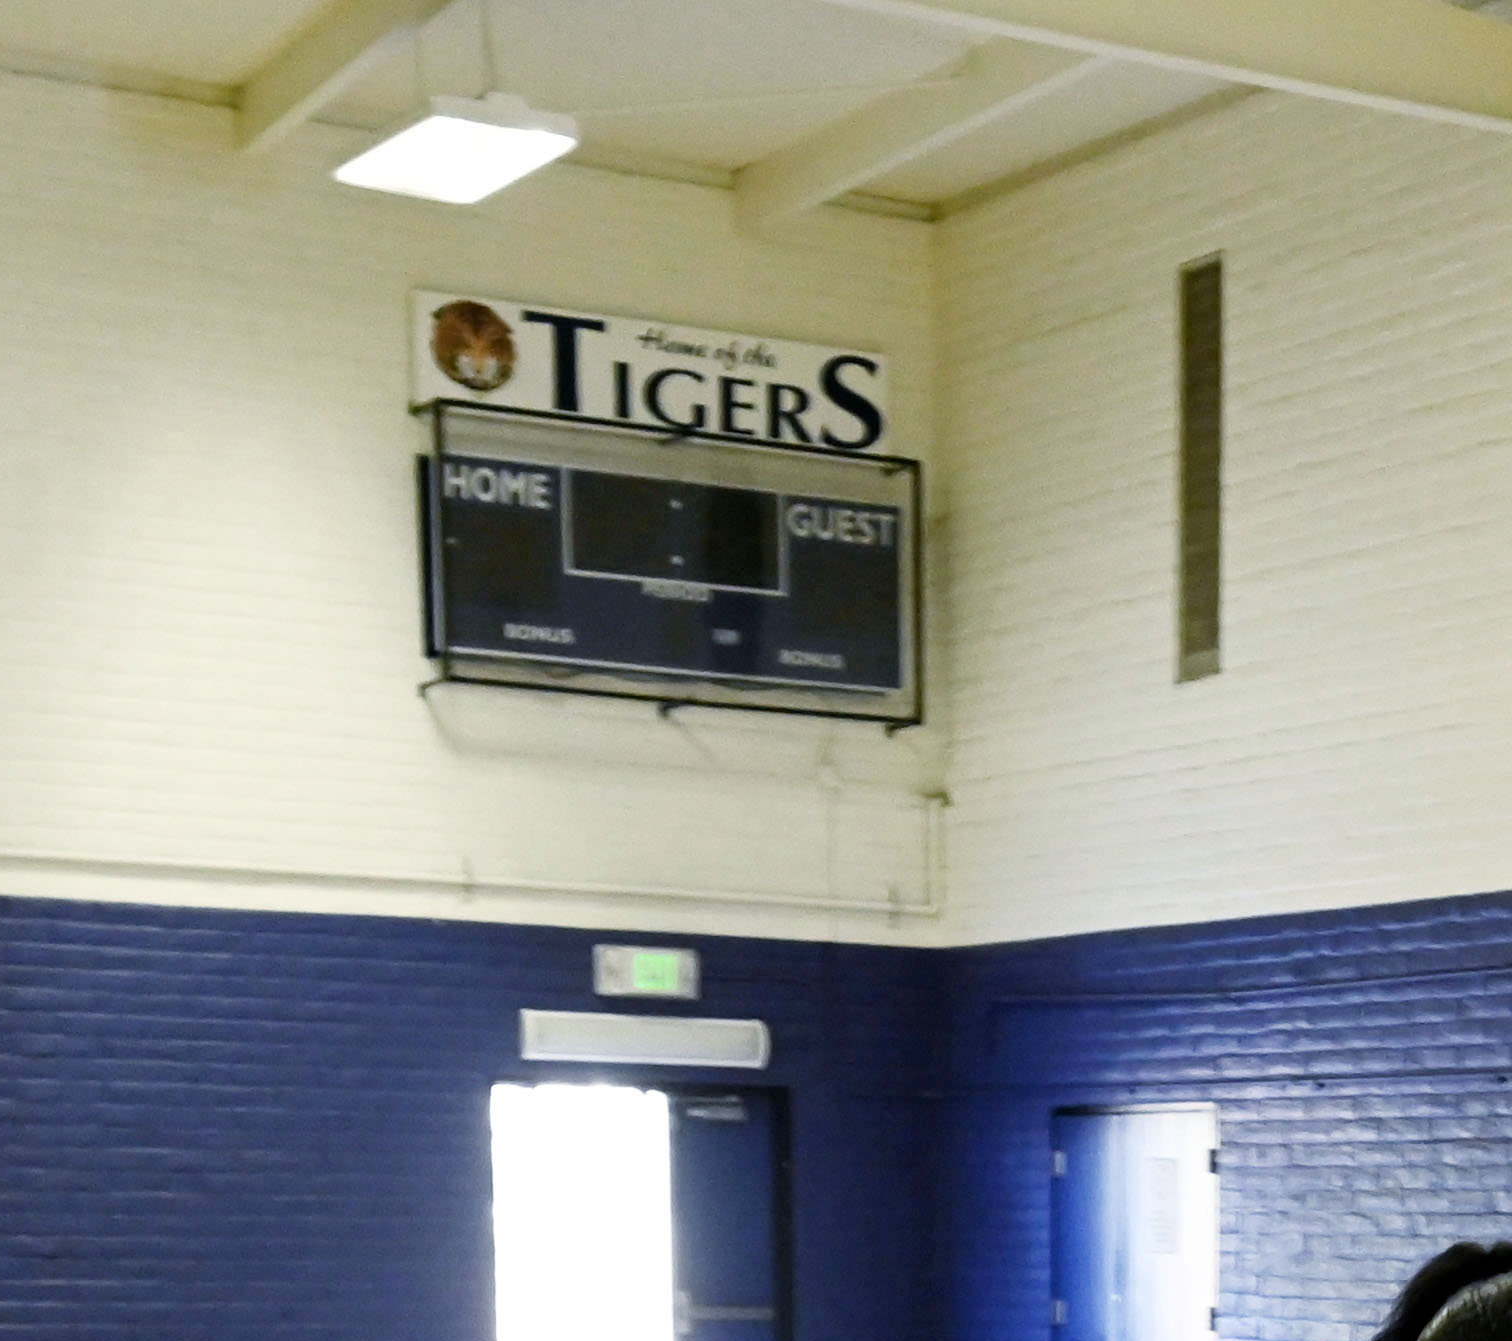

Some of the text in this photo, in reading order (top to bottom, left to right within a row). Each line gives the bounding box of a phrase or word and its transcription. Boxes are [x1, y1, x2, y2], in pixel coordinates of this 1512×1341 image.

[522, 309, 885, 451] TIGERS
[444, 462, 551, 510] HOME
[788, 504, 897, 547] GUEST
